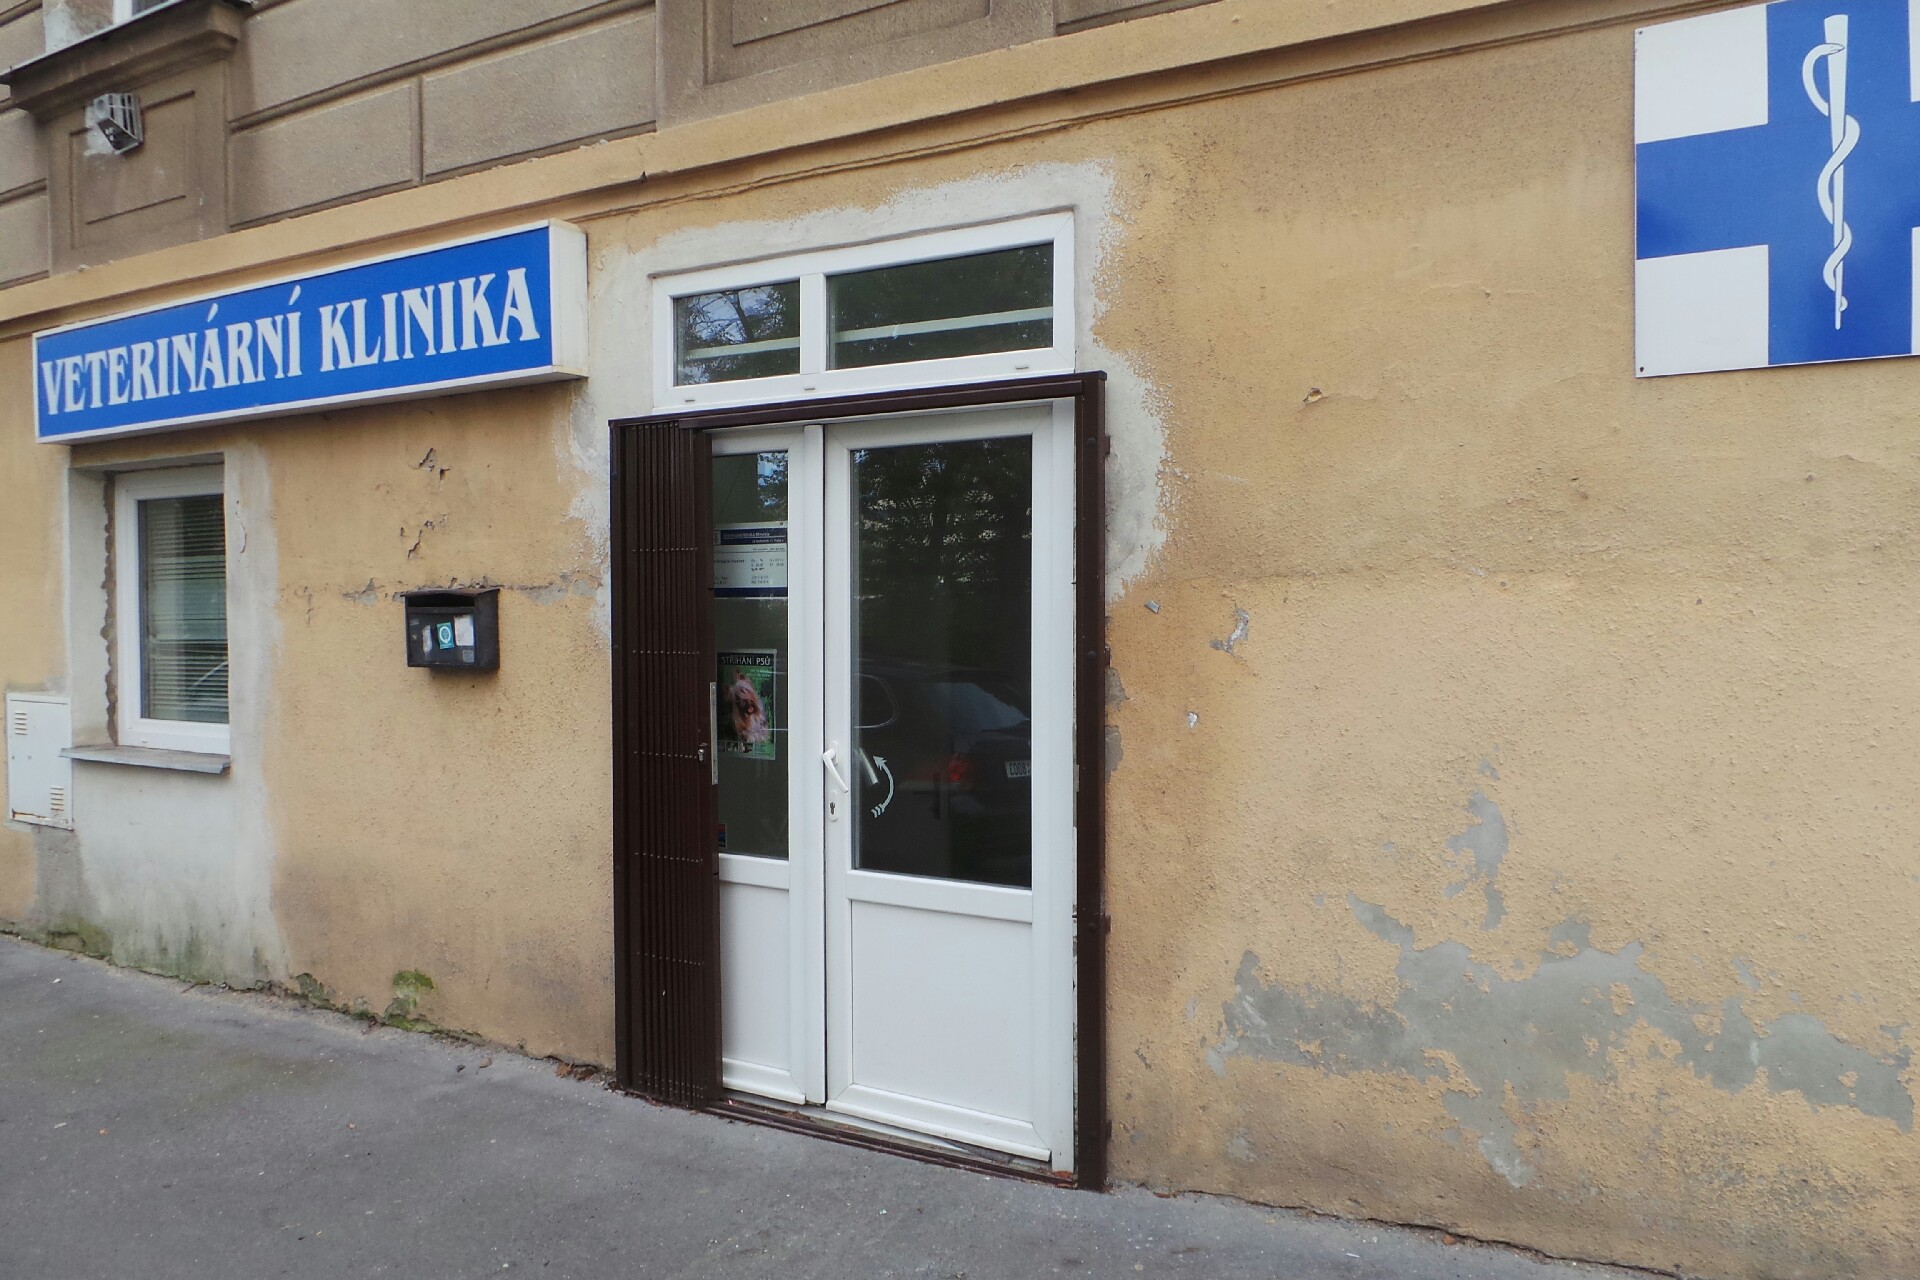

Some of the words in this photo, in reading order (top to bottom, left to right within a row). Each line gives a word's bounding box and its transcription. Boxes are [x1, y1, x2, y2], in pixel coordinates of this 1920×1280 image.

[41, 285, 302, 415] VETERINÁRNÍ
[319, 268, 540, 372] KLINIKA
[756, 655, 771, 666] PSŮ
